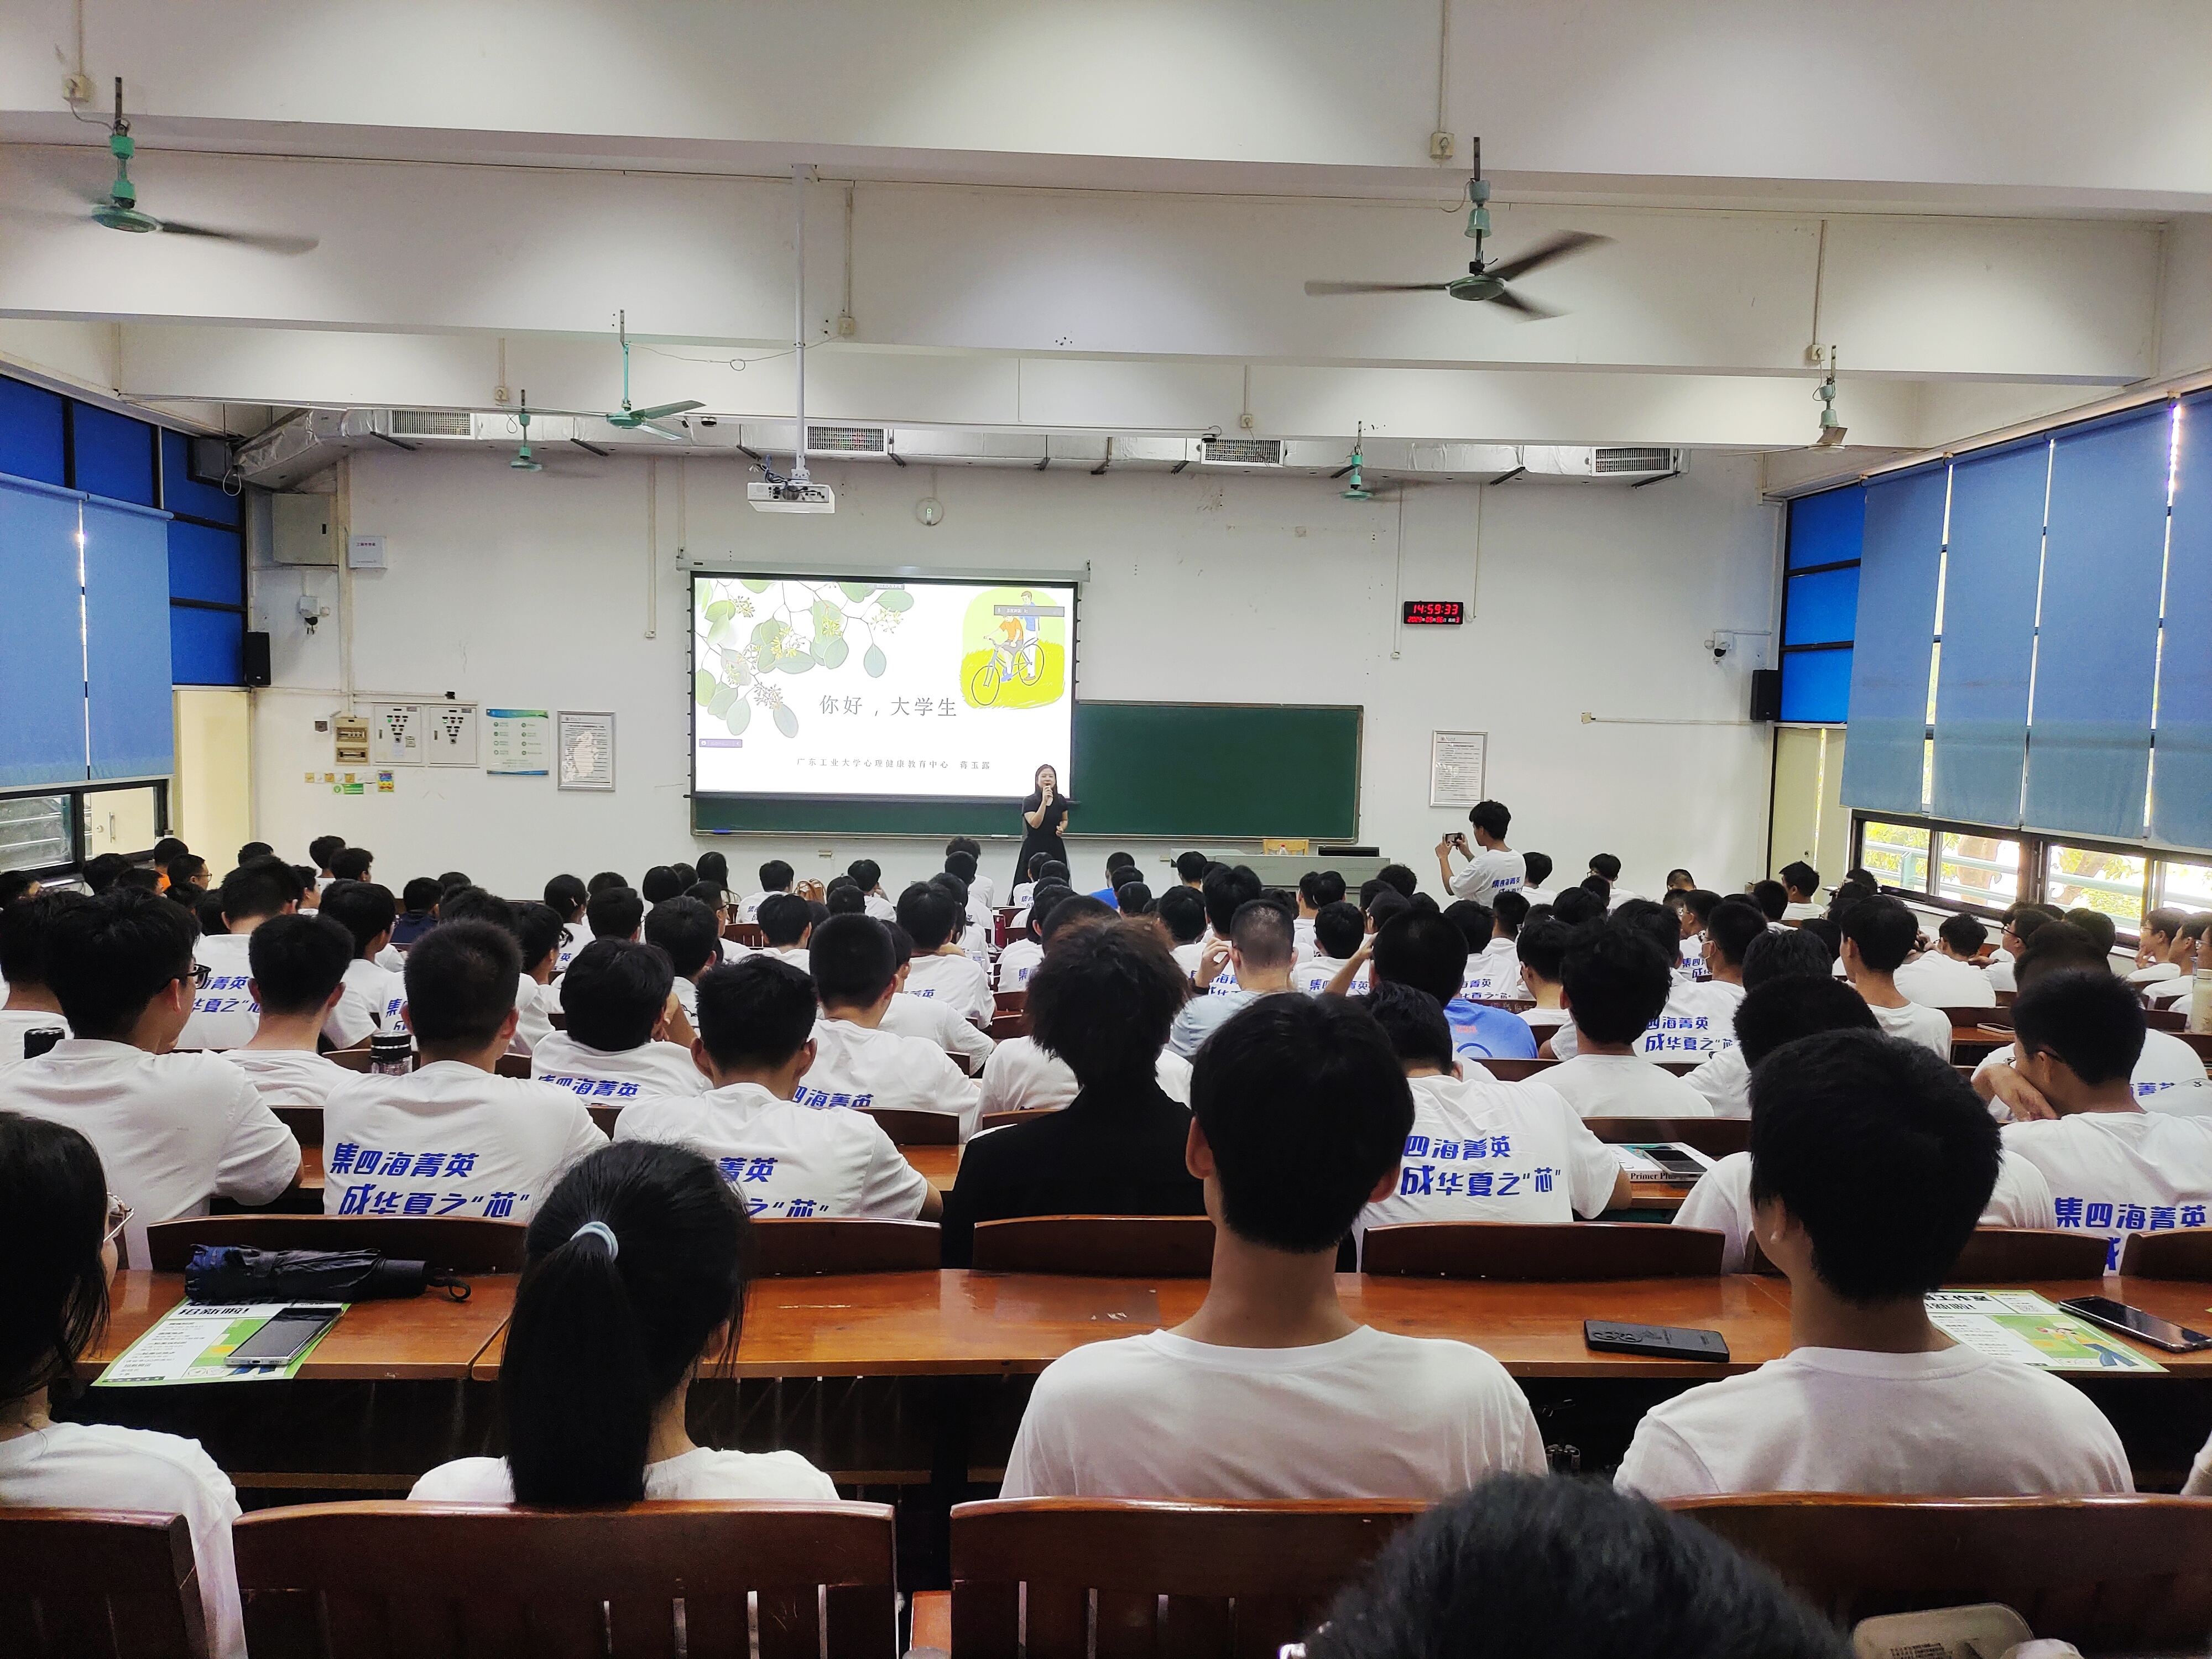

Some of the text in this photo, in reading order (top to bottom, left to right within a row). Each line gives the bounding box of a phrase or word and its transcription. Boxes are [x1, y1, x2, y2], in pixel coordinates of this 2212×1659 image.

[1413, 604, 1458, 614] 14:59:33
[820, 695, 956, 716] 你好，大学生
[797, 758, 948, 769] 广东工业大学心理健康教育中心
[330, 1142, 479, 1178] 集四海菁英
[2054, 1197, 2206, 1230] 集四海菁英
